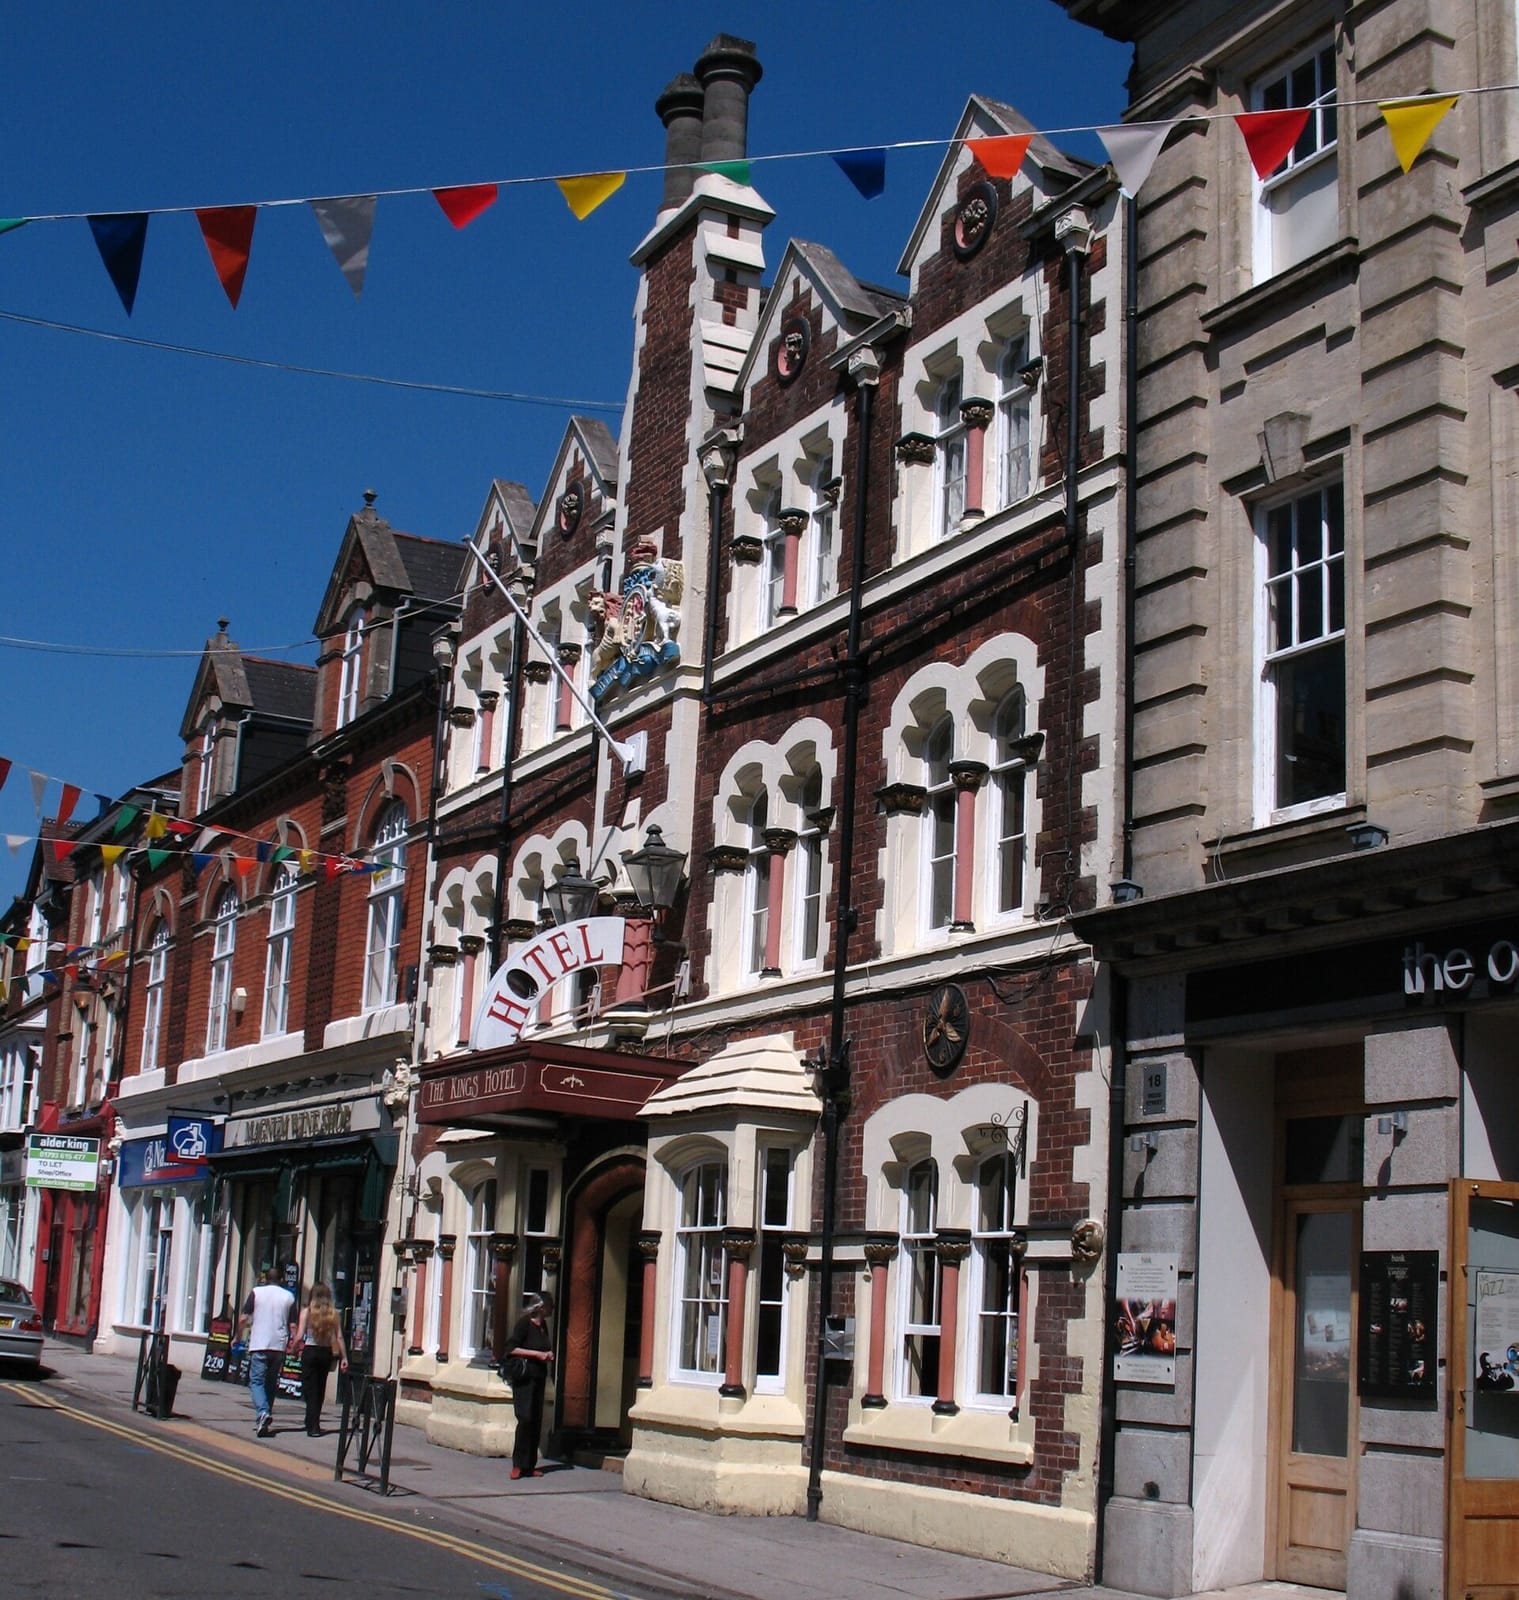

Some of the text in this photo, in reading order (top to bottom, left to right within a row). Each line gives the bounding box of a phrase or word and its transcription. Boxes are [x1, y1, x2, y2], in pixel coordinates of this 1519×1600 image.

[487, 924, 603, 1032] HOTEL
[1401, 941, 1474, 994] the
[428, 1068, 516, 1102] THE KINGS HOTEL
[1148, 1074, 1161, 1088] 18
